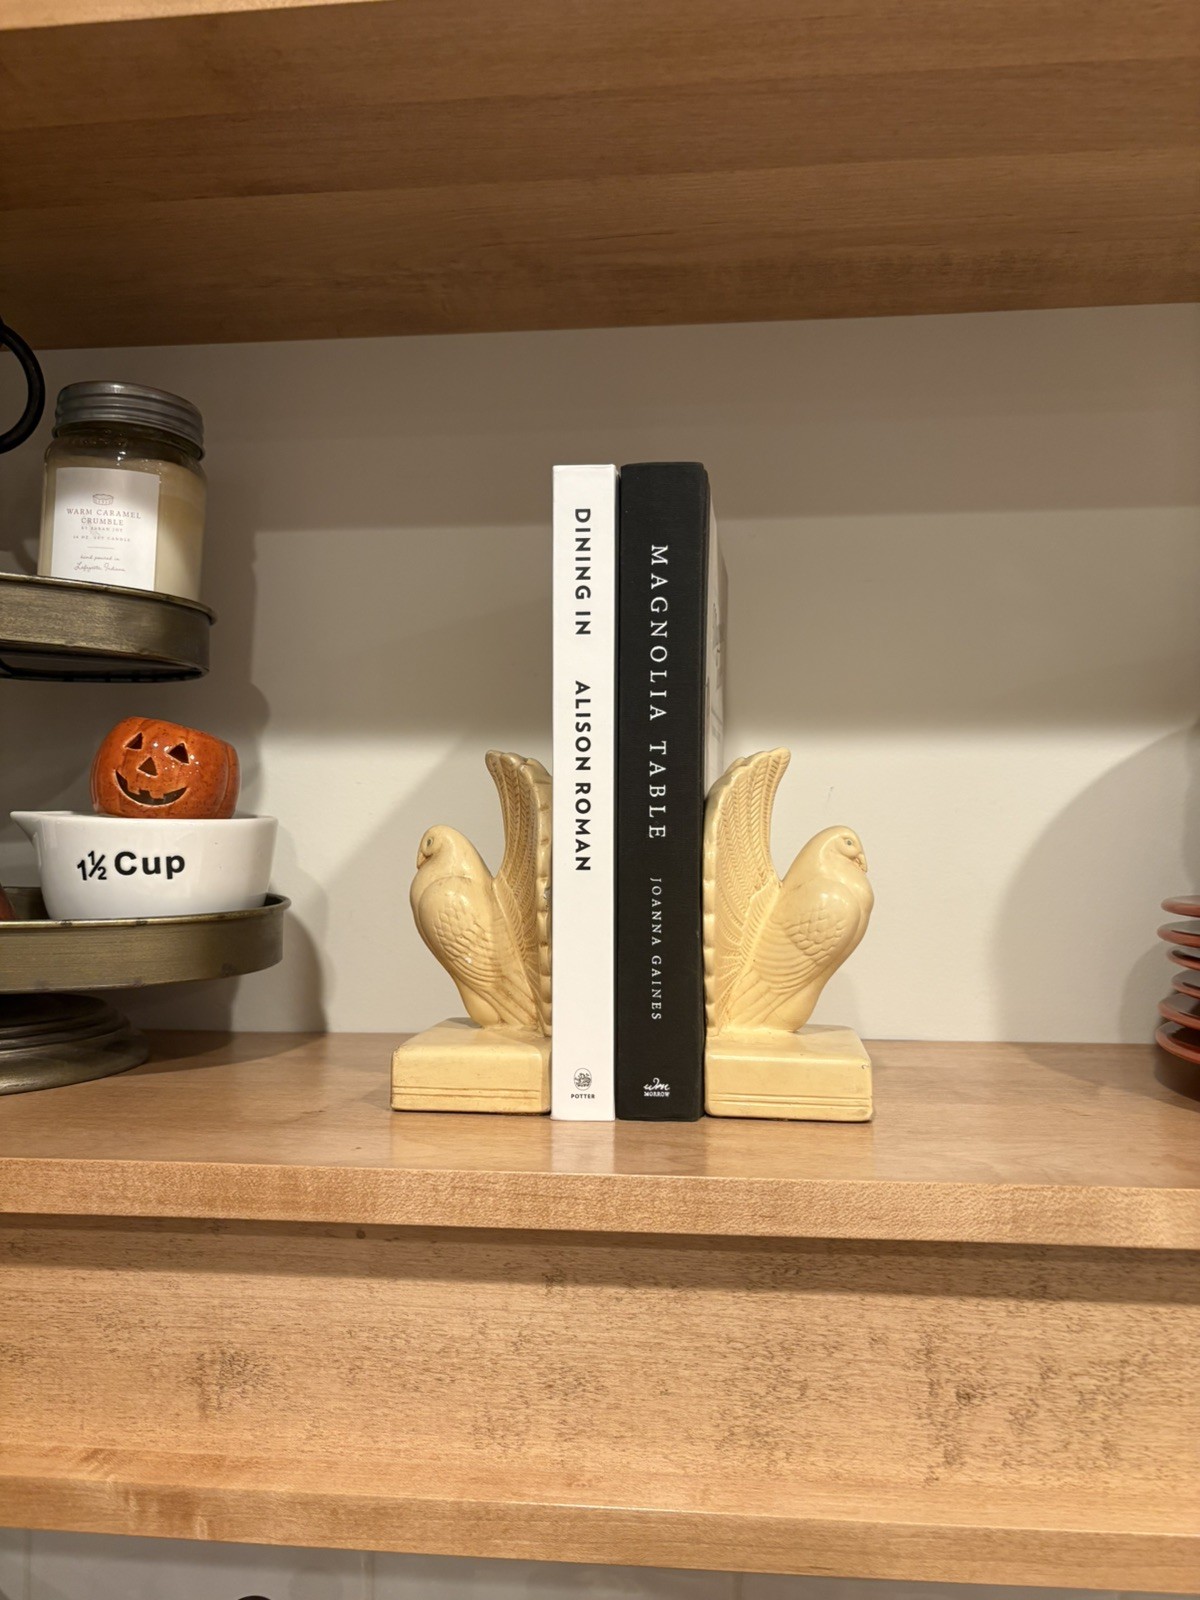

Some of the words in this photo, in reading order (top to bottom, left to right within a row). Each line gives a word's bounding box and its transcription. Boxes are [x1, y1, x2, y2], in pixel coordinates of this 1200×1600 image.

[80, 517, 124, 526] CRUMBLE
[96, 509, 142, 520] CARAMEL
[574, 509, 591, 600] DINING
[575, 612, 591, 635] IN
[649, 544, 669, 721] MAGNOLIA
[574, 680, 591, 771] ALISON
[648, 741, 667, 839] TABLE
[575, 782, 591, 871] ROMAN
[114, 851, 185, 879] Cup
[650, 877, 663, 946] JOANNA
[651, 955, 662, 1020] GAINES
